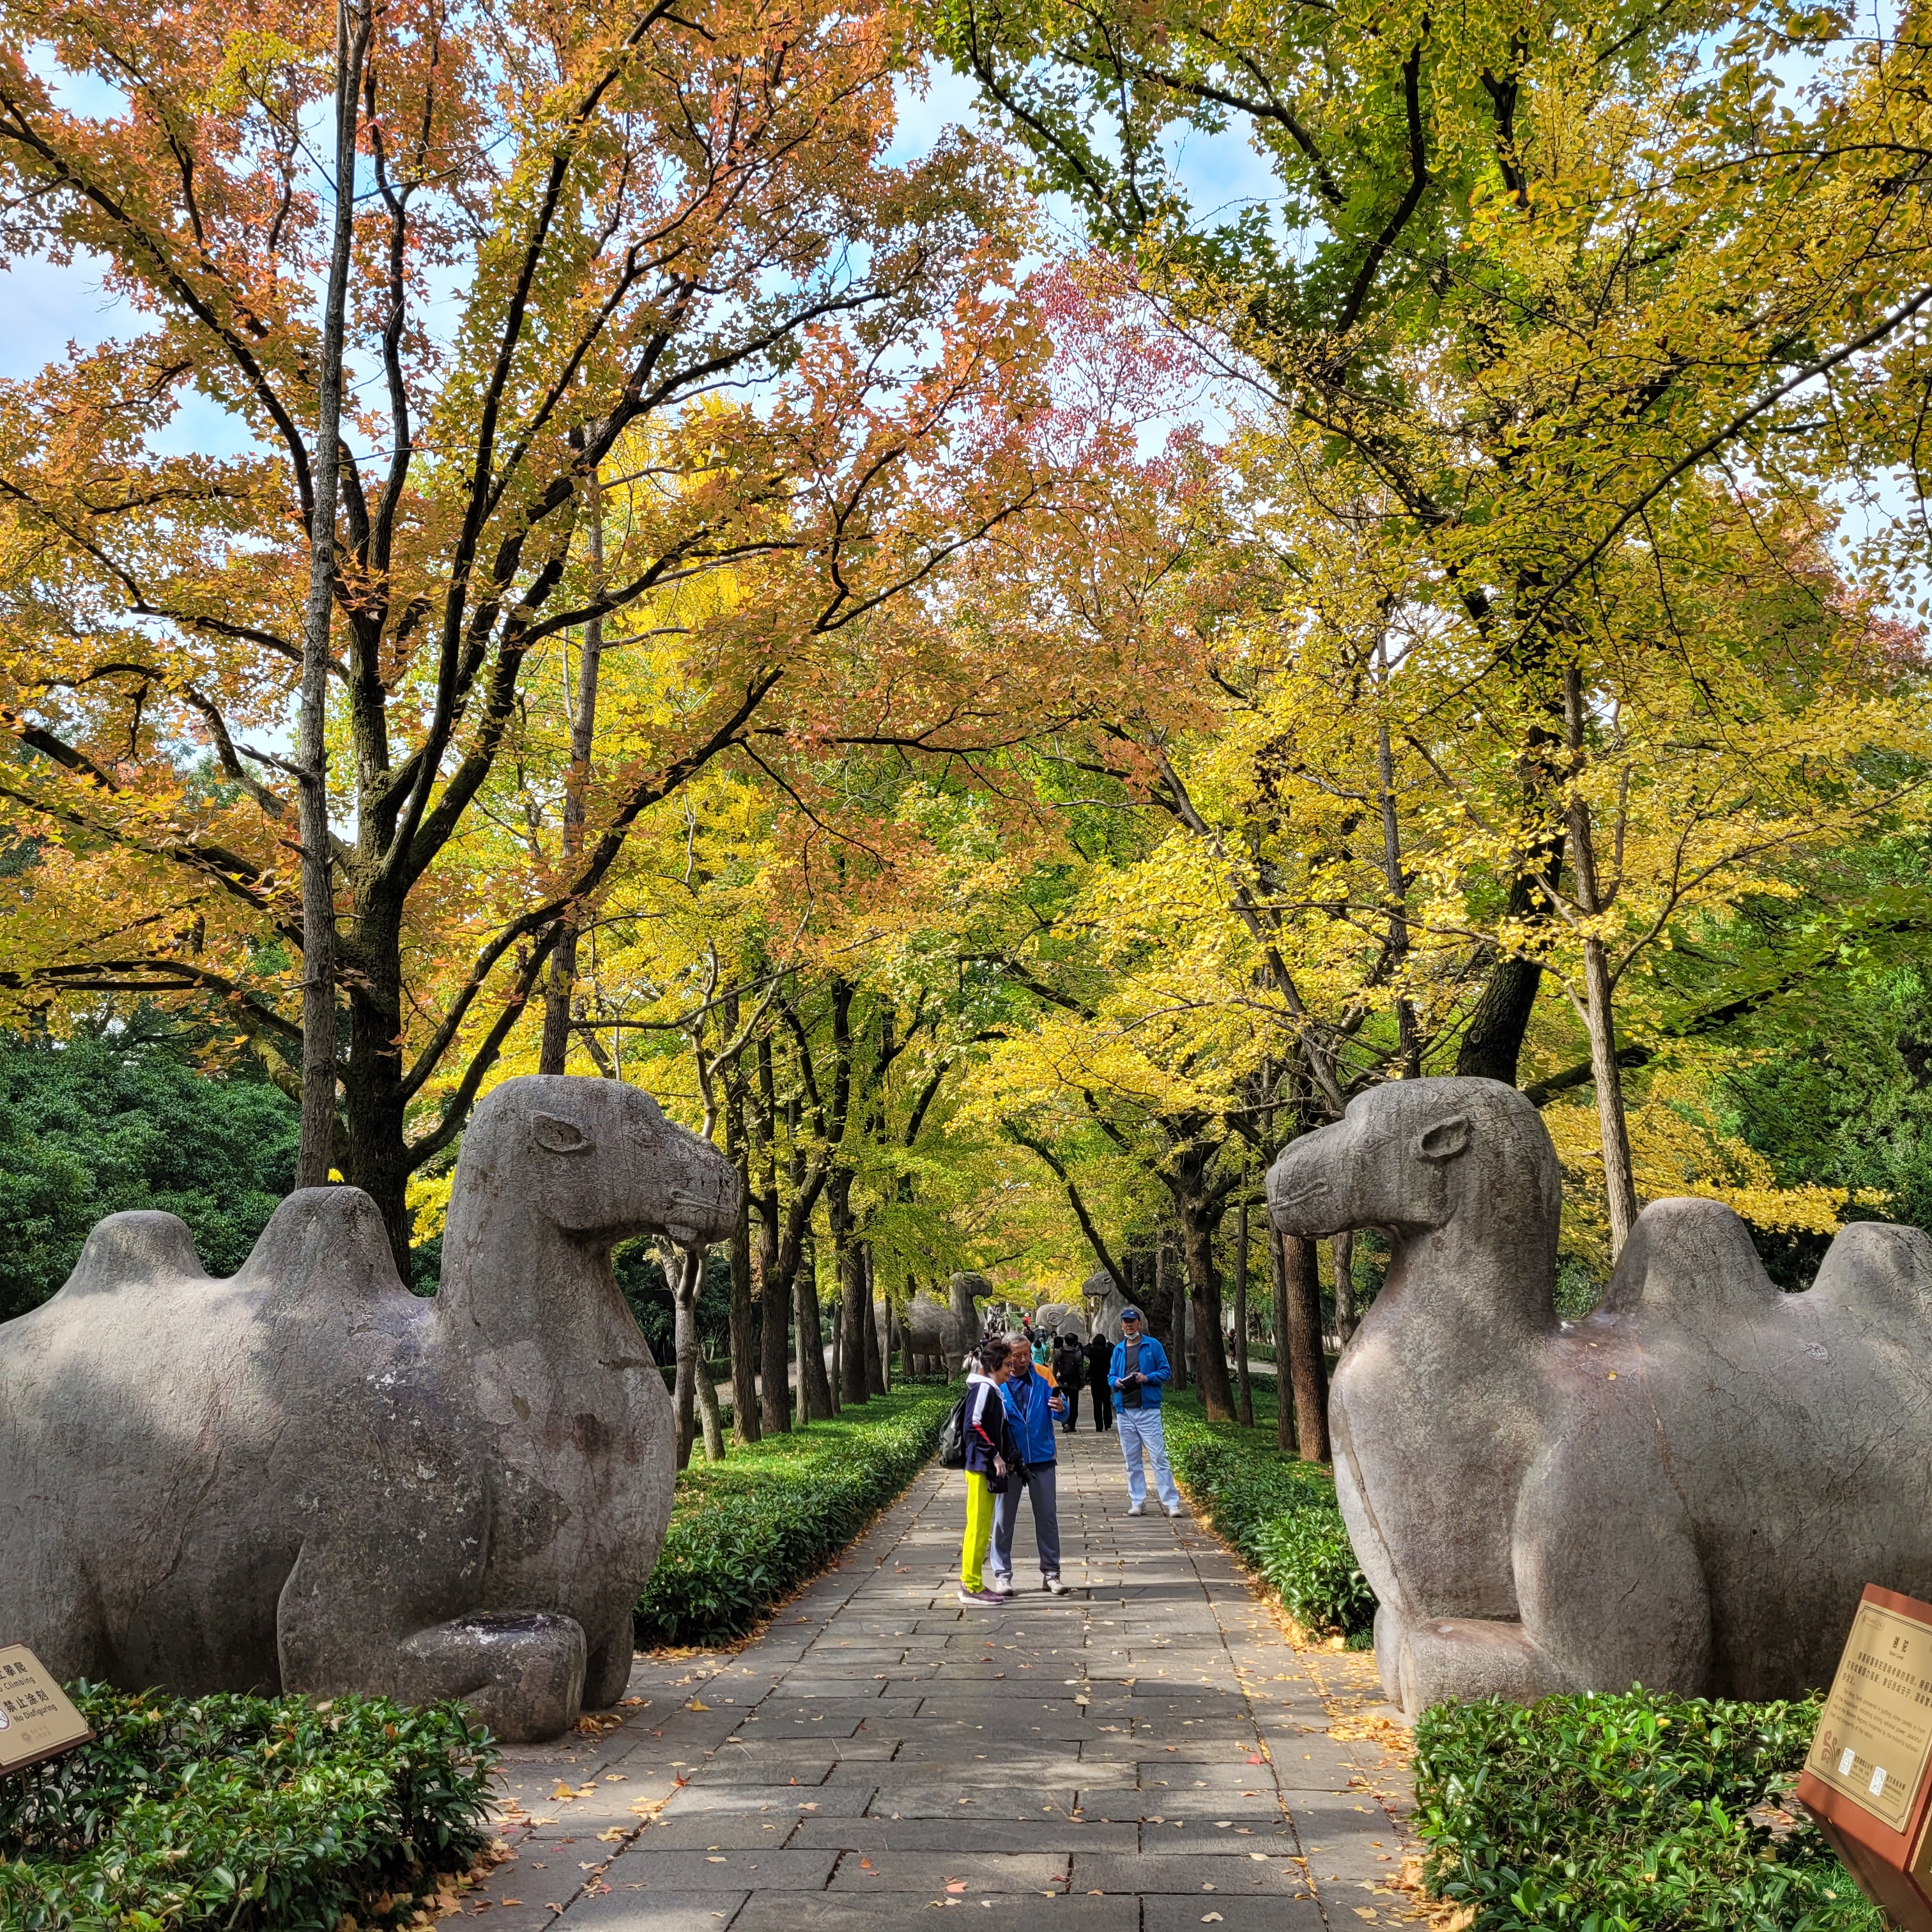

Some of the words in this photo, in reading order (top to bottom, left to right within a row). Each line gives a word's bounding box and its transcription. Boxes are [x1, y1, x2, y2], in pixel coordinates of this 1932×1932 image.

[4, 1676, 36, 1690] Climbing
[3, 1689, 49, 1713] 禁止涂刻
[13, 1715, 24, 1723] No
[23, 1704, 58, 1719] Disfiguring
